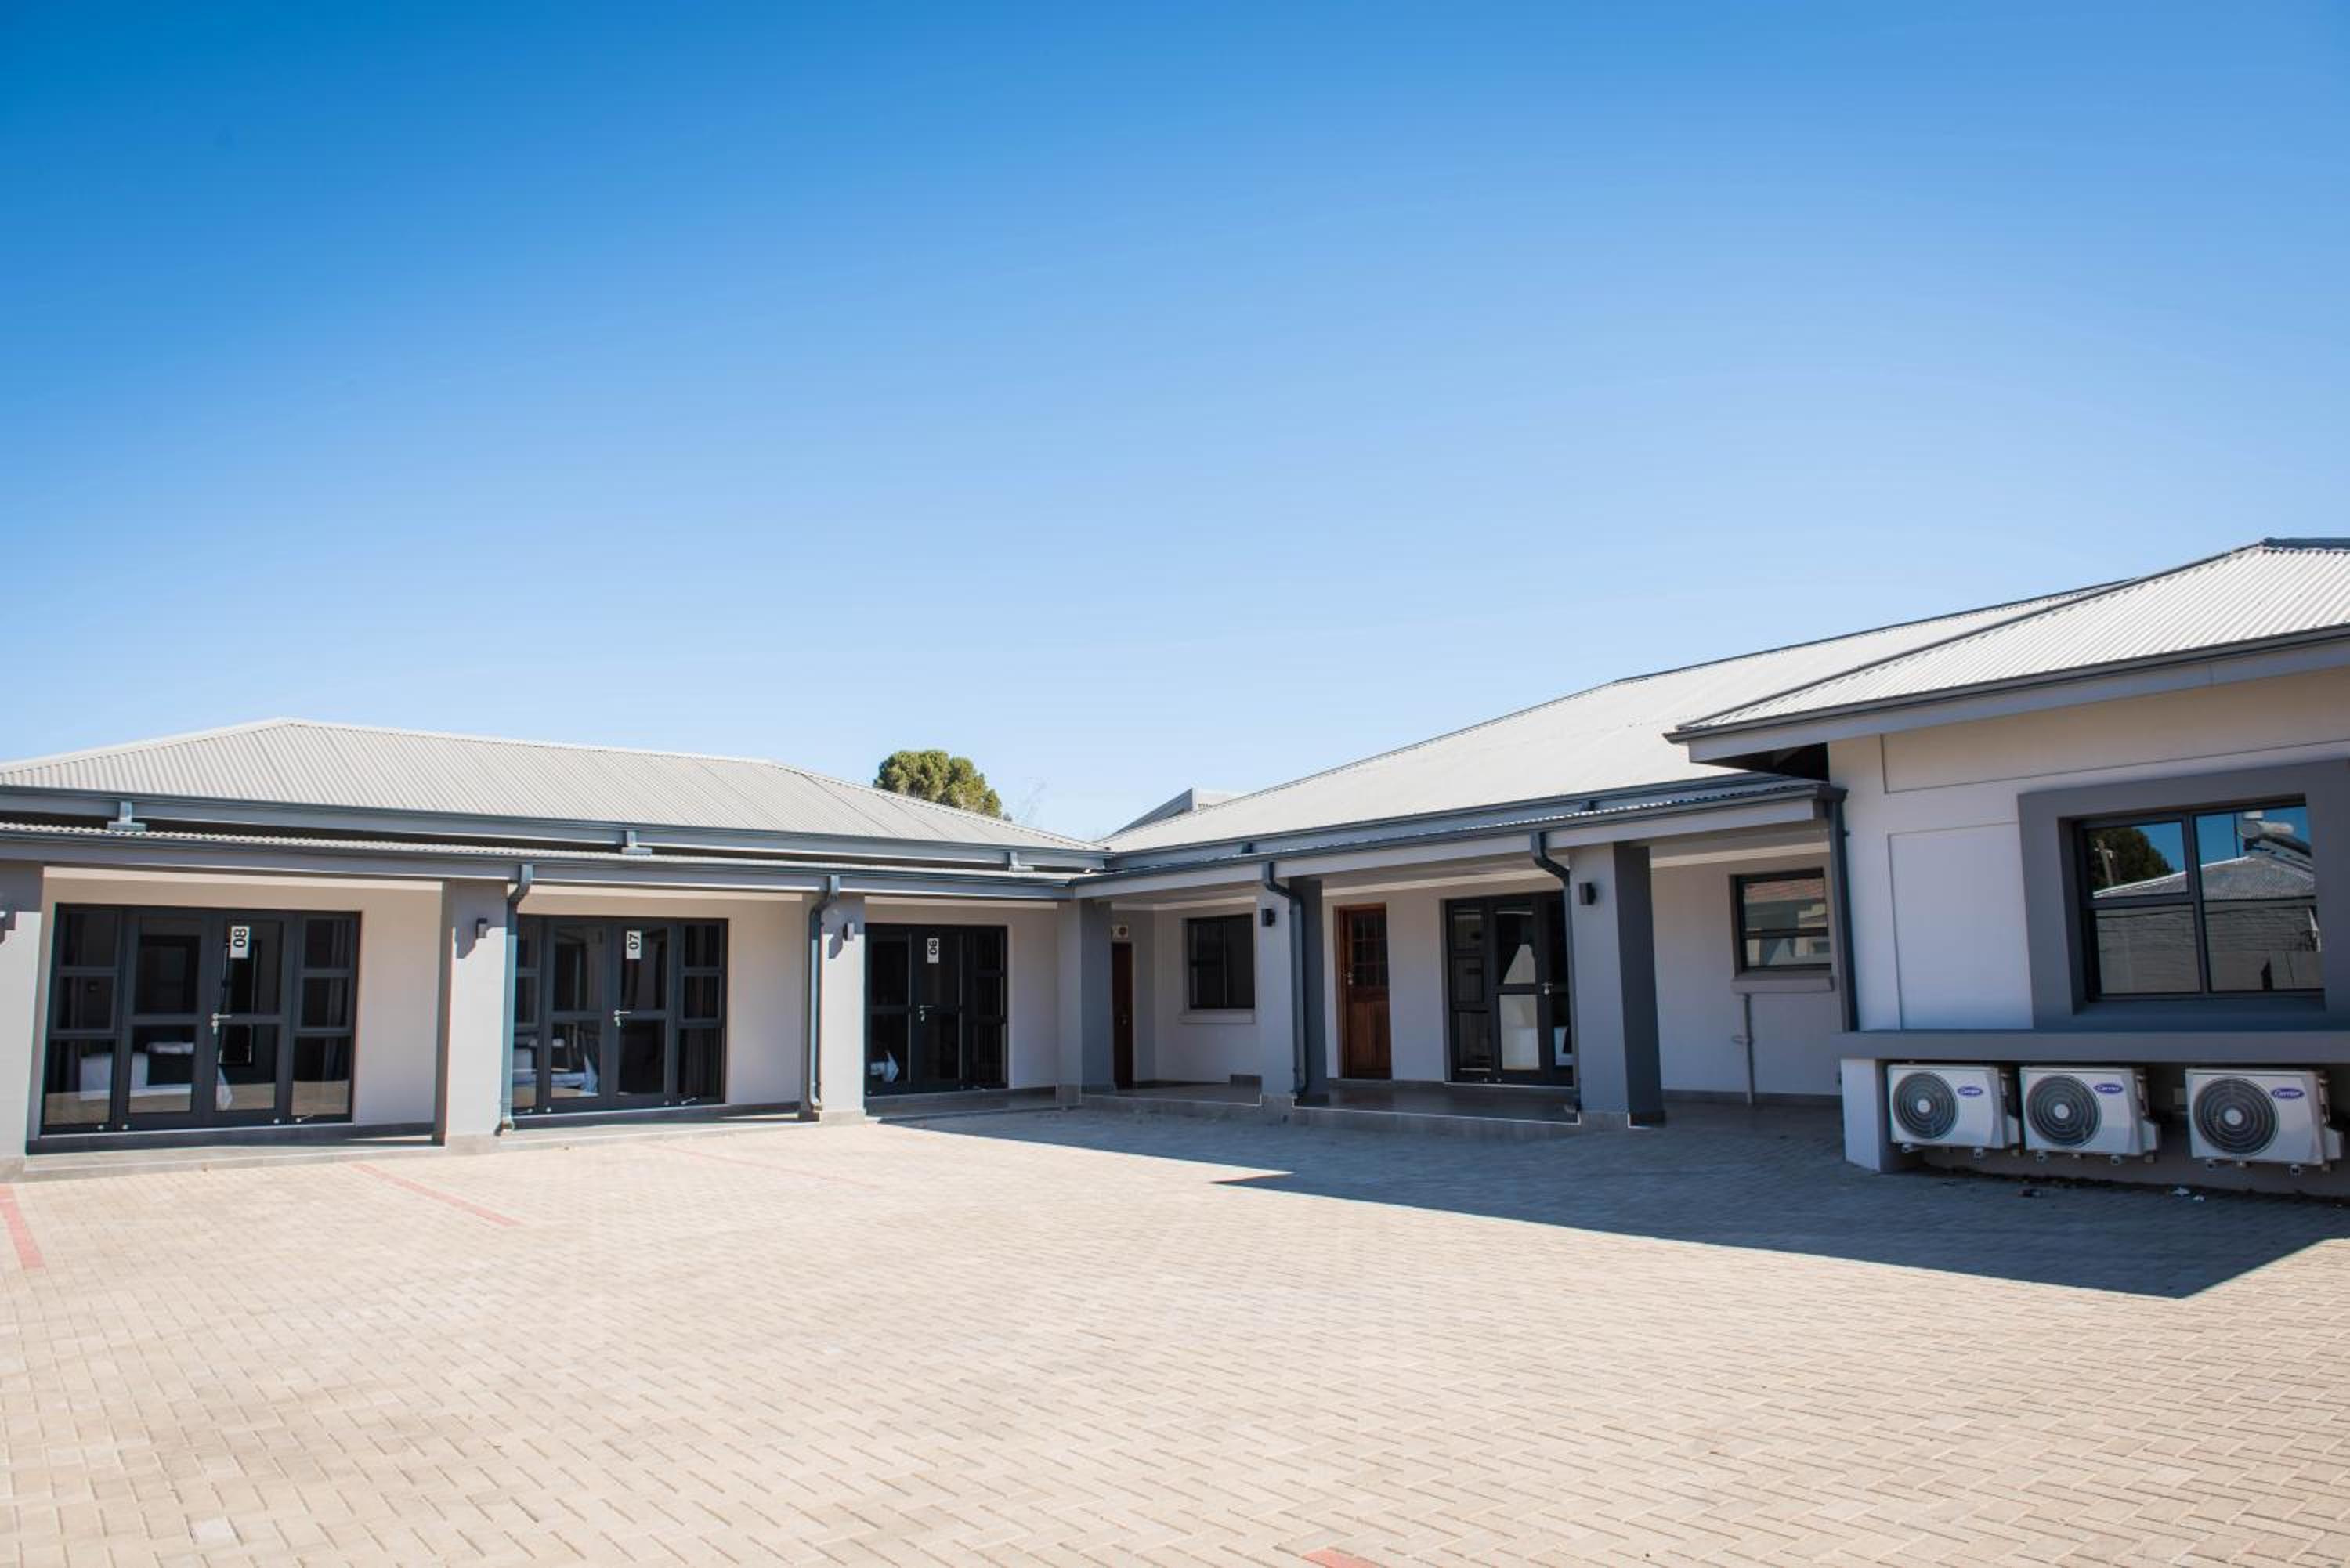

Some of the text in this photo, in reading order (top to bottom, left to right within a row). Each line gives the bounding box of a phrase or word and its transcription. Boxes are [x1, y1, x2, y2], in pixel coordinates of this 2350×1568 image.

[233, 928, 247, 948] 08
[628, 933, 639, 950] 07
[928, 939, 938, 955] 06
